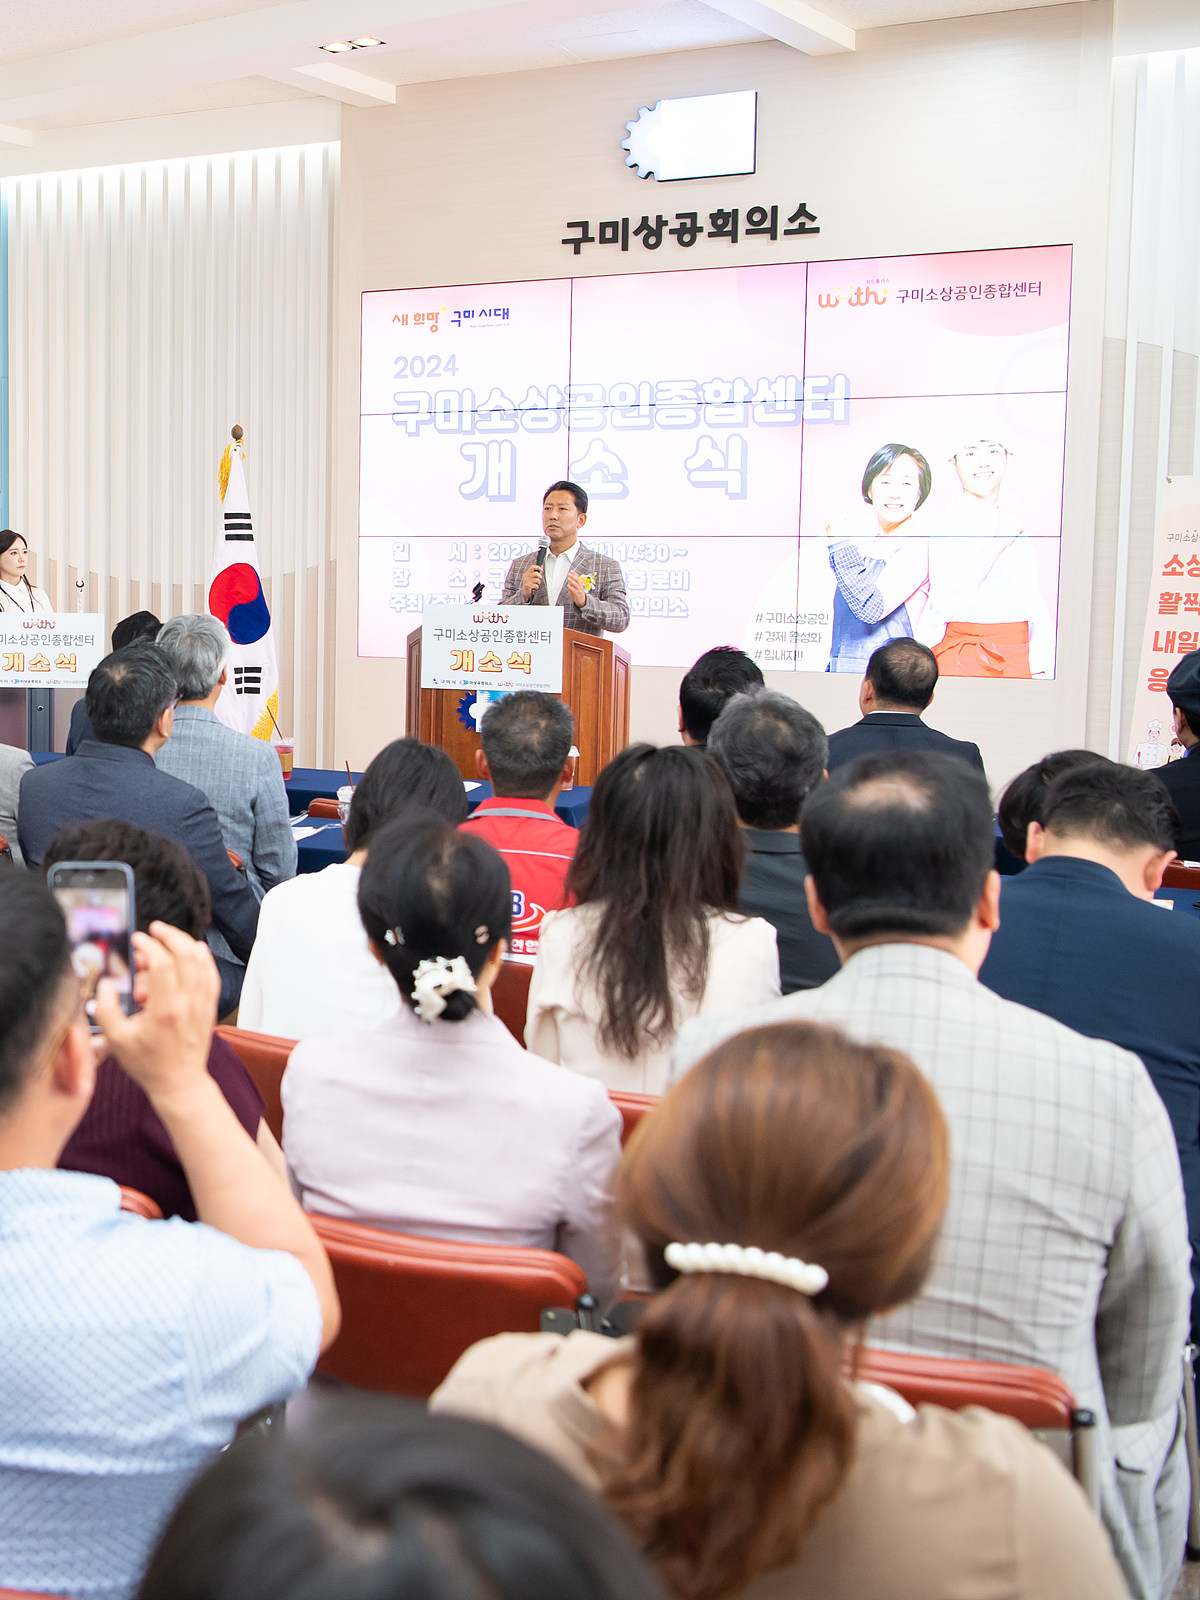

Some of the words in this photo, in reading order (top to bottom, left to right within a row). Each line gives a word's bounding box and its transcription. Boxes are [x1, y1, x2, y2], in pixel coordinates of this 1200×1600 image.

[561, 202, 821, 255] 구미상공회의소
[896, 281, 1042, 304] 구미소상공인종합센터
[392, 313, 409, 326] 새
[413, 311, 440, 333] 희망
[451, 309, 475, 327] 구미
[479, 307, 510, 320] 시대
[393, 354, 459, 379] 2024
[392, 373, 851, 437] 구미소상공인종합센터
[1166, 530, 1200, 543] 구미소상
[629, 596, 689, 618] 회의소
[433, 628, 552, 645] 구미소상공인종합센터
[1, 651, 77, 673] 개소식
[449, 650, 532, 674] 개소식
